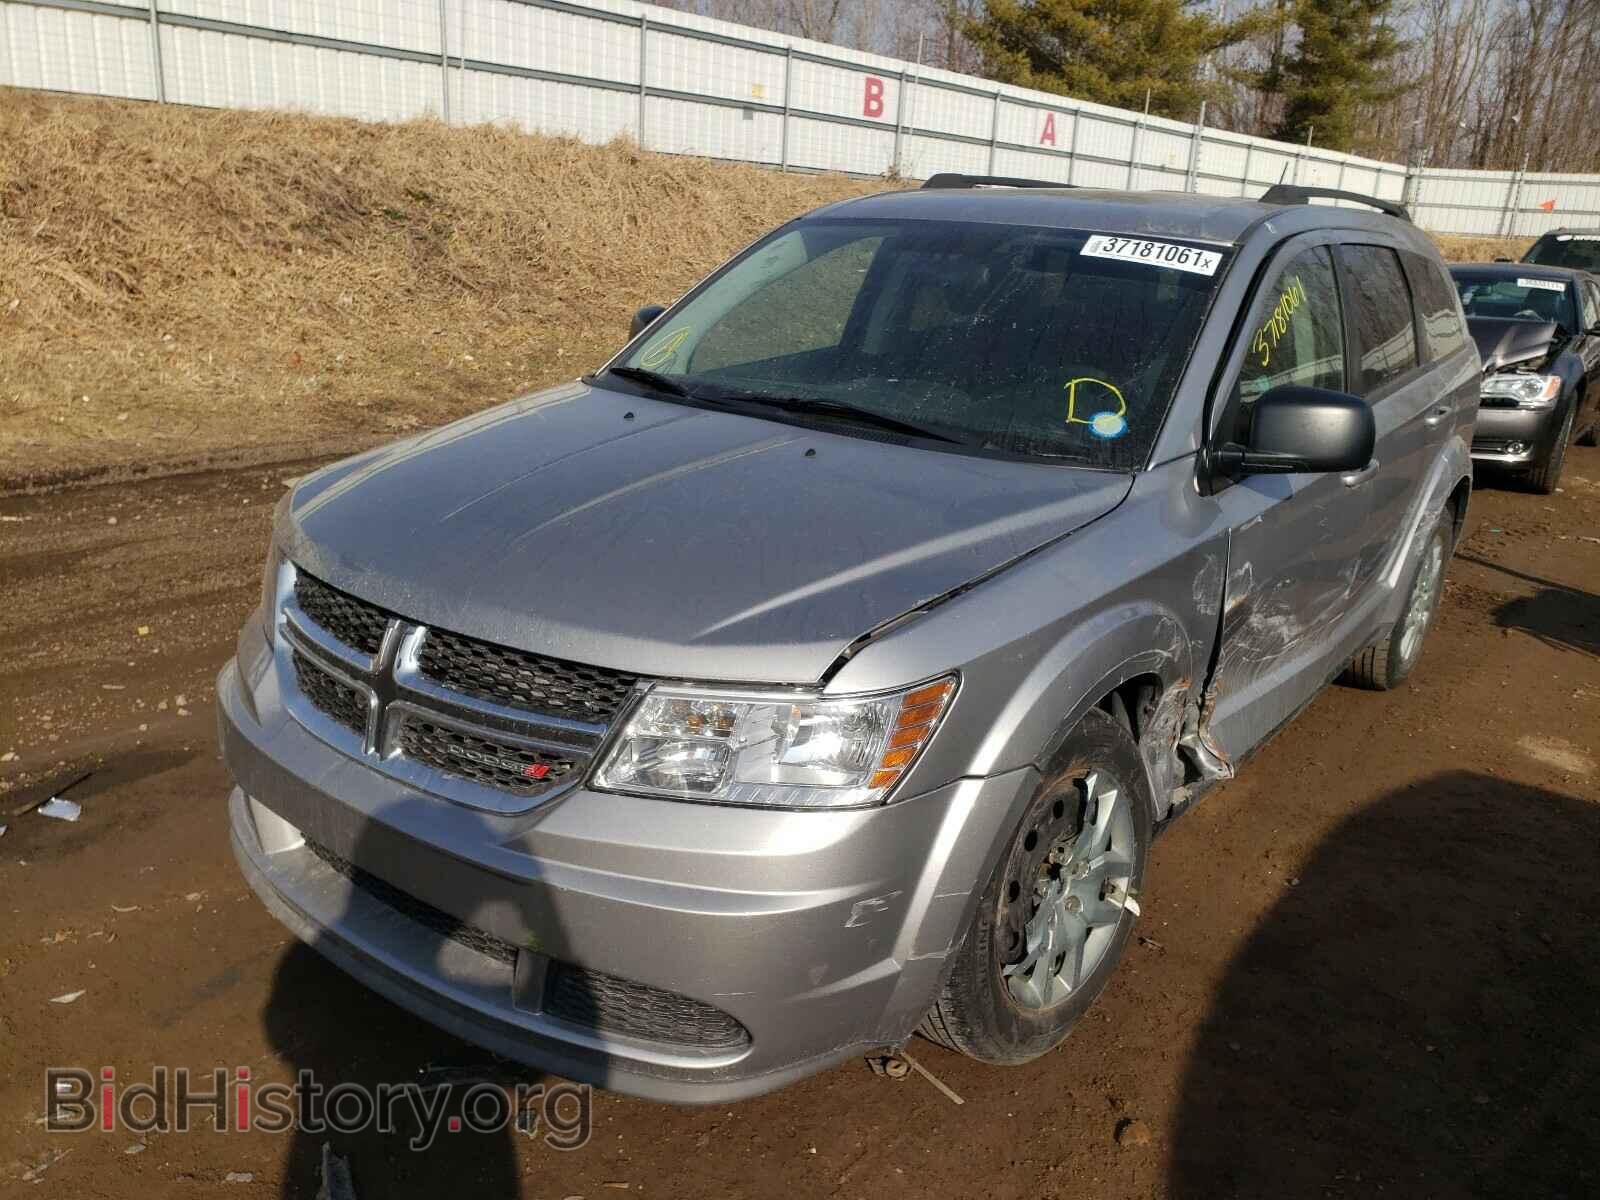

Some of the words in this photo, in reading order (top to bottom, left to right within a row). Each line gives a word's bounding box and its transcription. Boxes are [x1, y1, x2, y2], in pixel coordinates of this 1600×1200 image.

[863, 77, 884, 118] B
[1040, 112, 1056, 147] A
[1063, 377, 1127, 425] D
